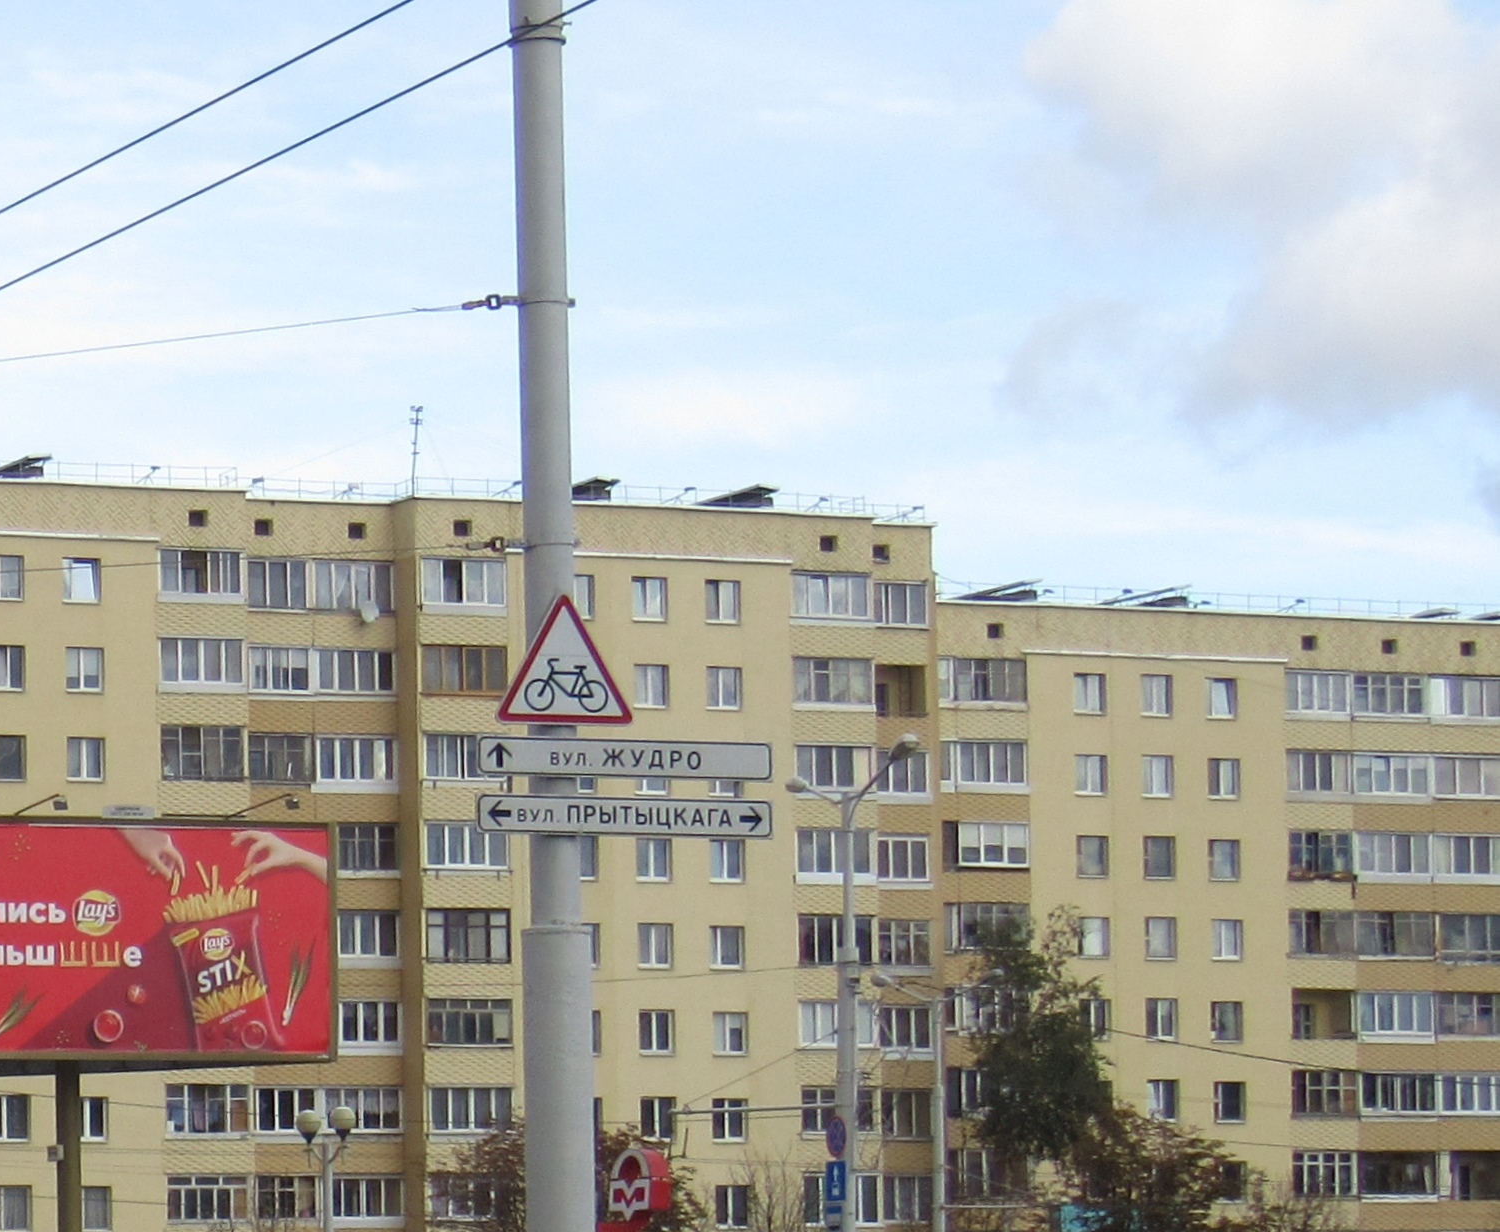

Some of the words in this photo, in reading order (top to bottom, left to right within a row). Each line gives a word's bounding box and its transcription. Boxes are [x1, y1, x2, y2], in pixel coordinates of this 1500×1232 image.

[601, 748, 701, 770] ЖУДРО
[567, 804, 732, 829] ПРЫТЫЦКАГА
[197, 950, 253, 993] STIX
